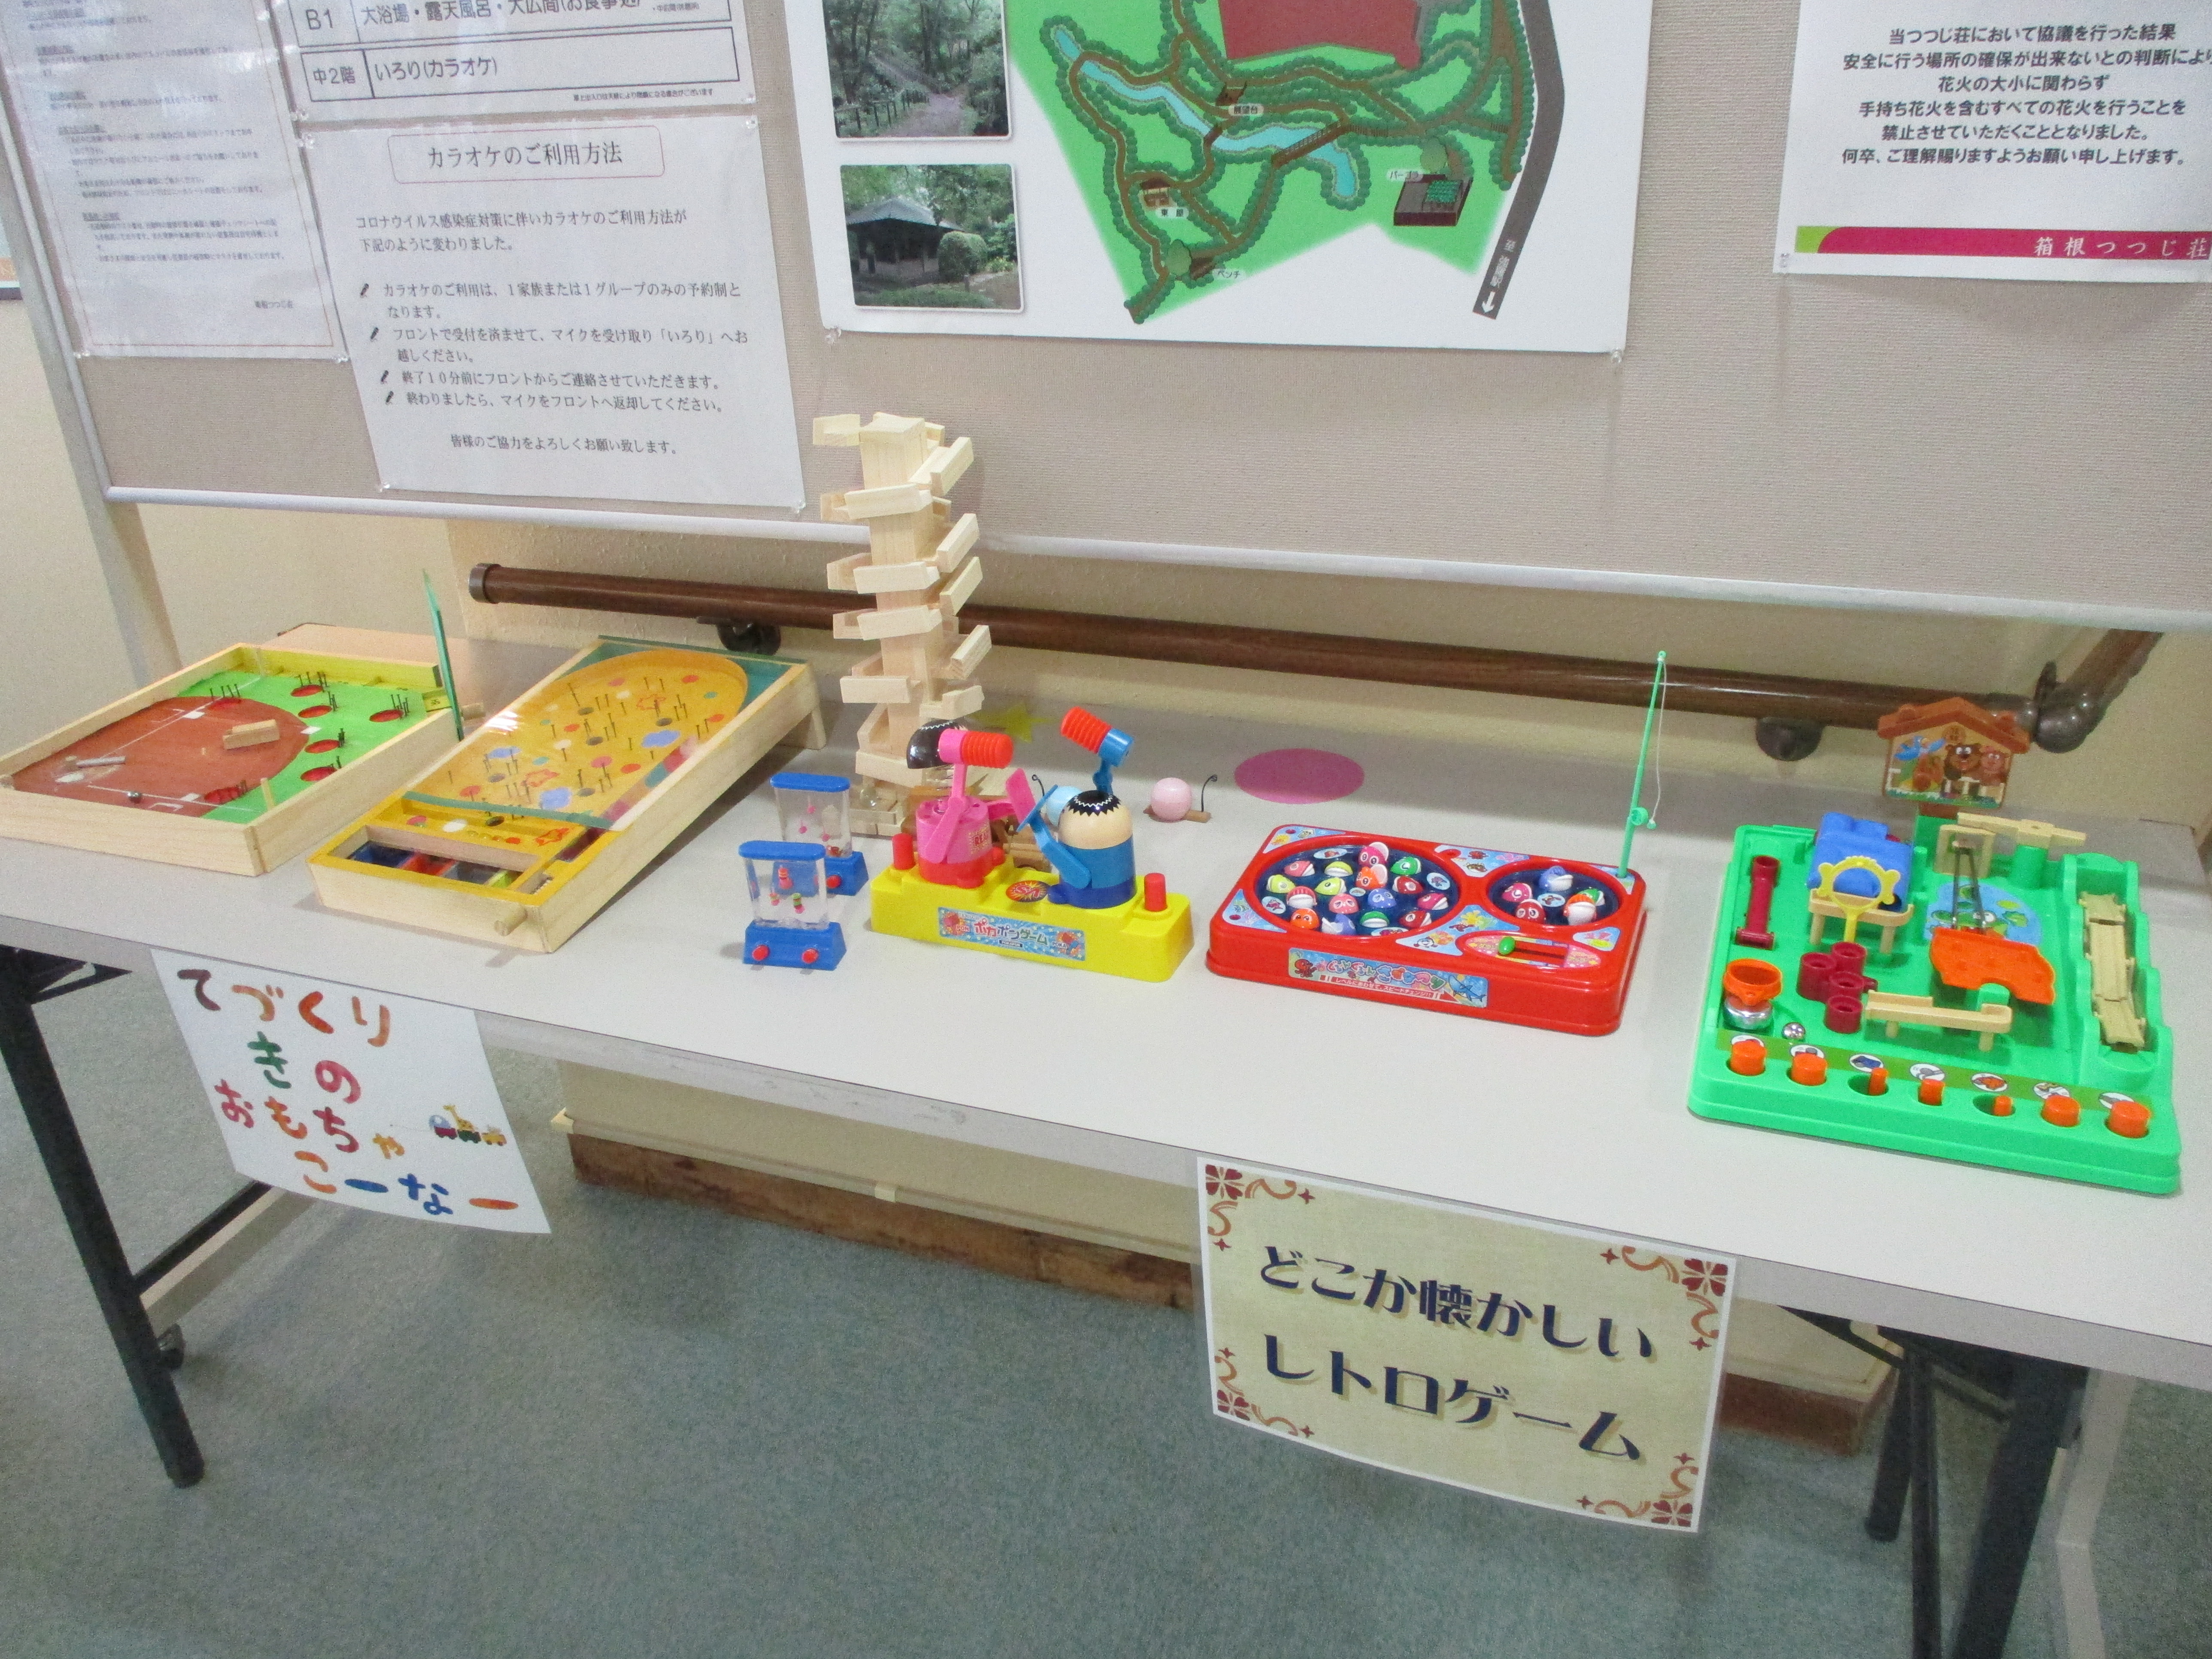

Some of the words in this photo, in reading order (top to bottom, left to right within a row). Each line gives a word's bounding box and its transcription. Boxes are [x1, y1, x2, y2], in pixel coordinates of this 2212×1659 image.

[305, 9, 333, 30] B1
[1889, 23, 2176, 45] 当つつじ荘において協議を行った結果
[313, 66, 356, 85] 中2階
[374, 56, 498, 81] いろり(カラオケ)
[1938, 74, 2110, 93] 花火の大小に関わらず
[1234, 106, 1258, 114] 展望台
[1859, 99, 2186, 118] 手持ち花火を含むすべての花火を行うことを
[1881, 124, 2148, 142] 禁止させていただくこととなりました。
[428, 140, 623, 168] カラオケのご利用方法
[1841, 147, 2185, 166] 何卒、ご理解賜りますようお願い申し上げます。
[356, 209, 687, 229] コロナウイルス感染症対策に伴いカラオケのご利用方法が
[360, 236, 513, 255] 下記のように変わりました。
[2033, 236, 2207, 258] 箱根つつじ荘
[1218, 270, 1240, 279] ベンチ
[388, 305, 441, 319] なります。
[397, 349, 474, 363] 越しください。
[407, 392, 722, 412] 終わりましたら、マイクをフロントへ返却してください。
[451, 434, 677, 454] 皆様のご協力をよろしくお願い致します。
[974, 918, 1049, 948] ポカポンゲーム
[177, 969, 391, 1048] てづくり
[214, 1079, 405, 1159] おもちゃ
[294, 1150, 519, 1215] こーなー
[1260, 1246, 1653, 1359] どこか懐かしい
[1264, 1334, 1641, 1461] レトロゲーム
